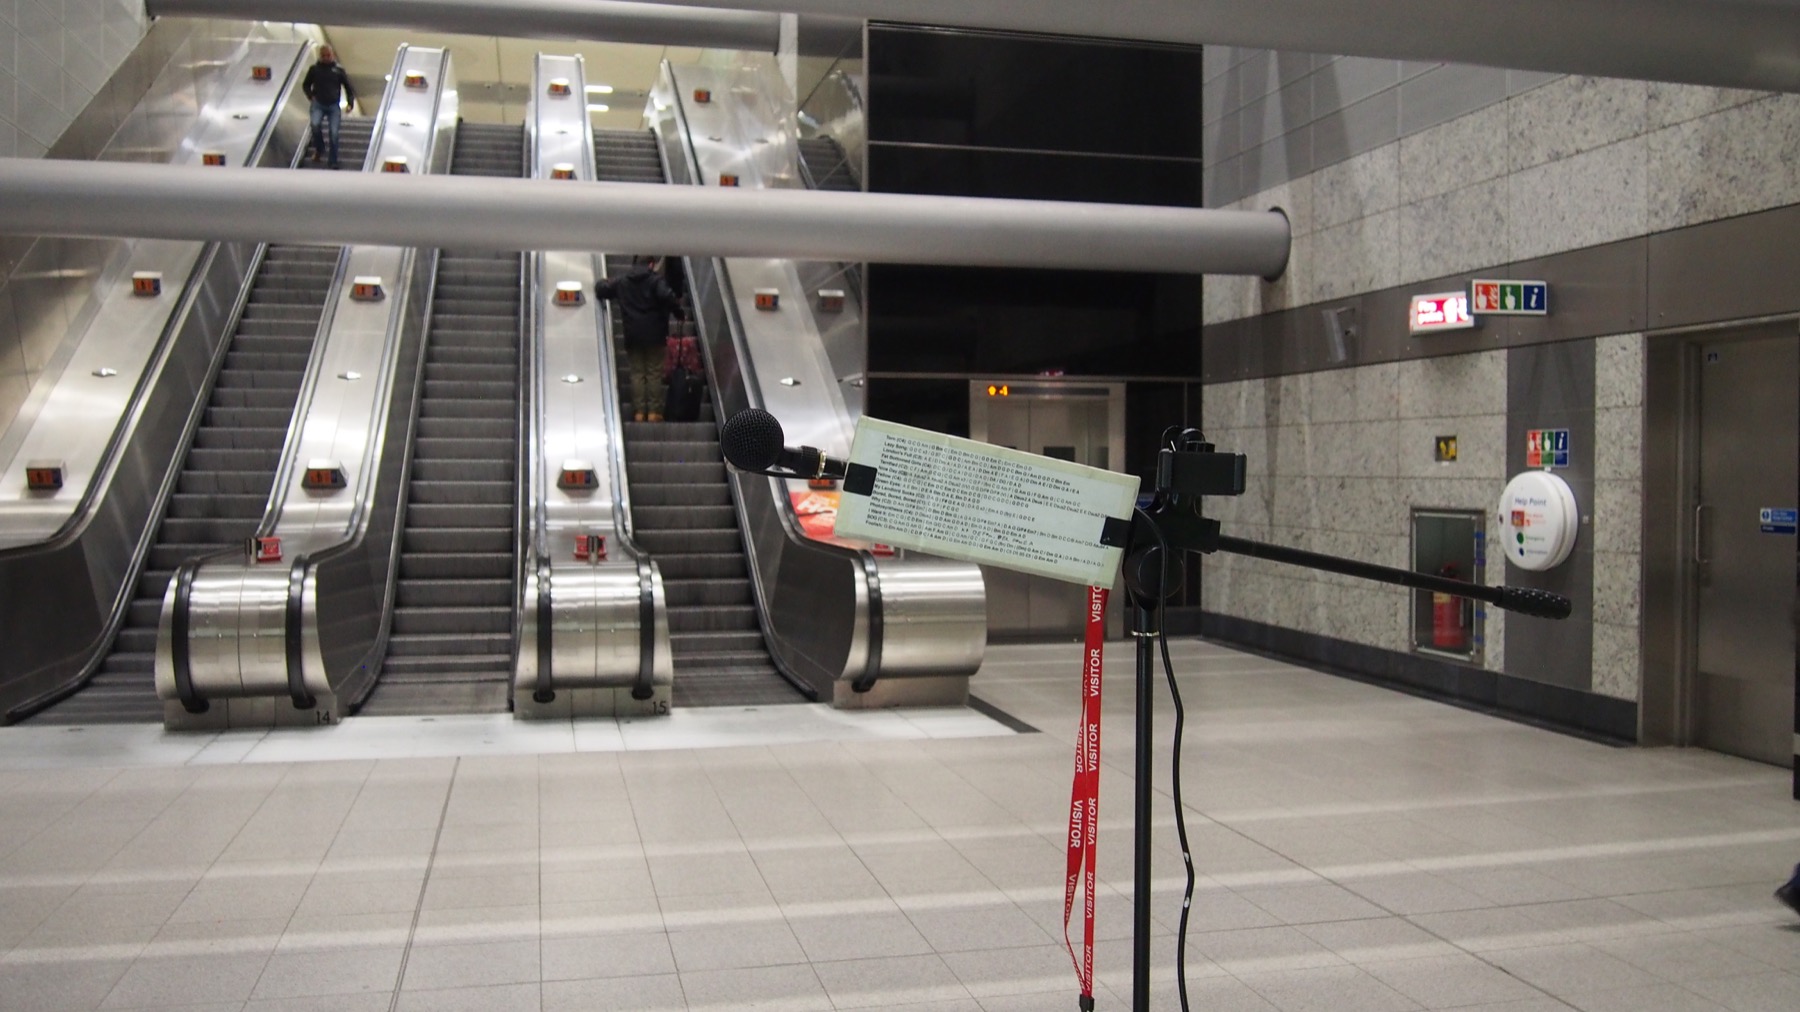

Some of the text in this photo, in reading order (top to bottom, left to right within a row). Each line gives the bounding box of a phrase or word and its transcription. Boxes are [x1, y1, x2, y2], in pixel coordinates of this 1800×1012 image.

[882, 447, 903, 455] London's
[869, 501, 902, 512] Photosynthesis
[1514, 498, 1546, 506] Help Point
[1092, 585, 1102, 622] VISITO
[1090, 649, 1100, 696] VISITOR
[316, 710, 330, 724] 14
[652, 701, 667, 715] 15
[1089, 724, 1098, 772] VISITOR
[1070, 800, 1083, 848] VISITOR
[1088, 798, 1096, 845] VISITOR
